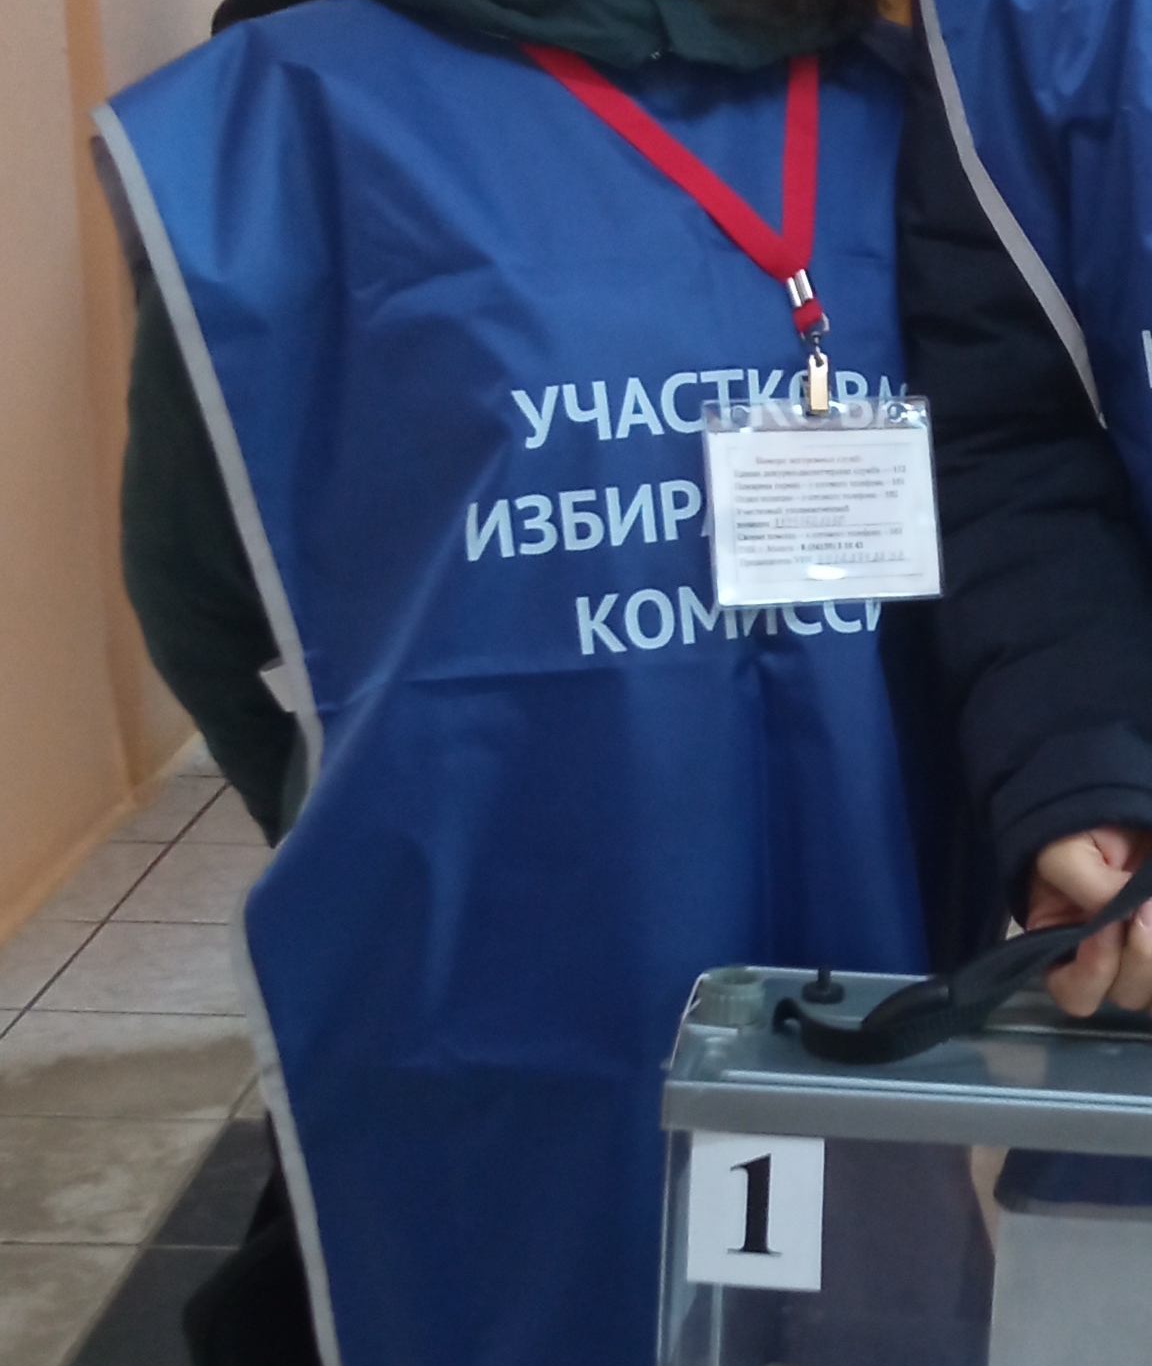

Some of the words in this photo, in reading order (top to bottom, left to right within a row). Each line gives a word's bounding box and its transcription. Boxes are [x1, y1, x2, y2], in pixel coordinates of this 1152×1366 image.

[511, 368, 909, 449] УЧАСТКОВА
[466, 479, 706, 561] ИЗБИР
[727, 1152, 783, 1255] 1
